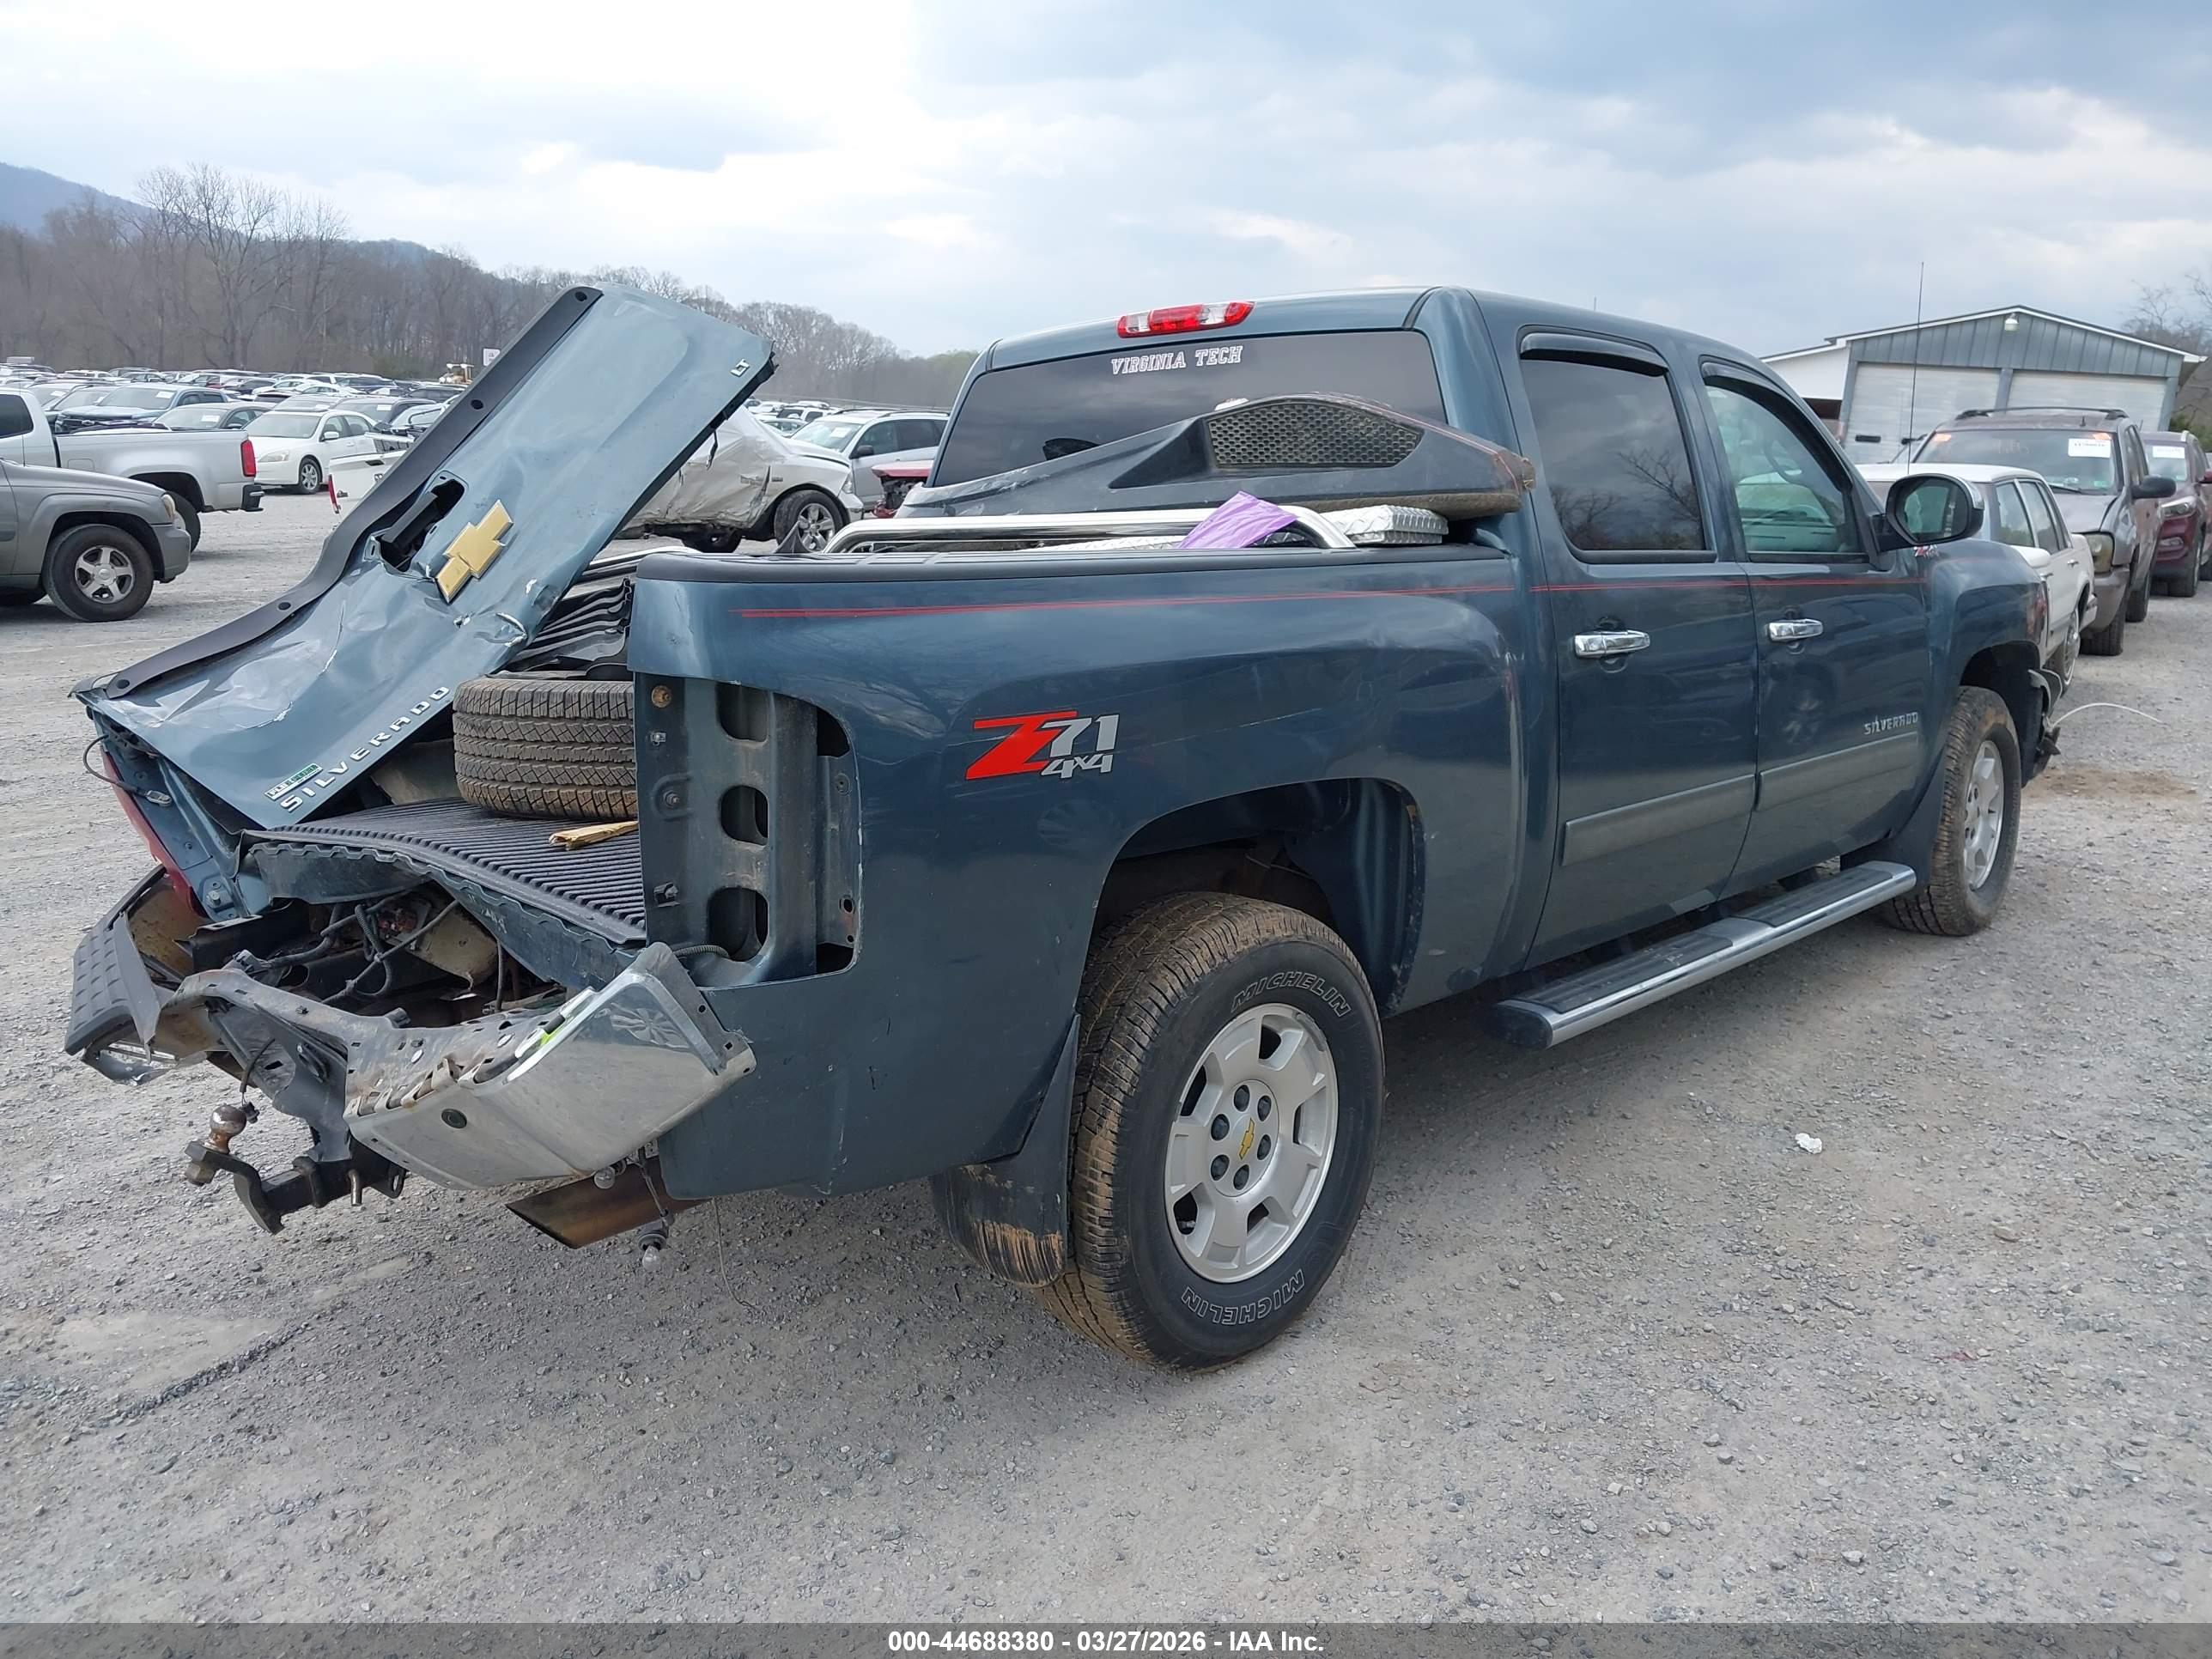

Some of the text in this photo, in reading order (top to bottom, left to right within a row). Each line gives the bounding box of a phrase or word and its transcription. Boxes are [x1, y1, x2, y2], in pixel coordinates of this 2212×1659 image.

[730, 359, 750, 377] LT
[1111, 345, 1243, 375] VIRGINIA TECH
[966, 711, 1119, 780] Z71
[1863, 712, 1919, 735] SILVERADO
[280, 686, 450, 812] SILVERADO
[1231, 971, 1352, 1018] MICHELIN
[1181, 1268, 1305, 1325] MICHELIN
